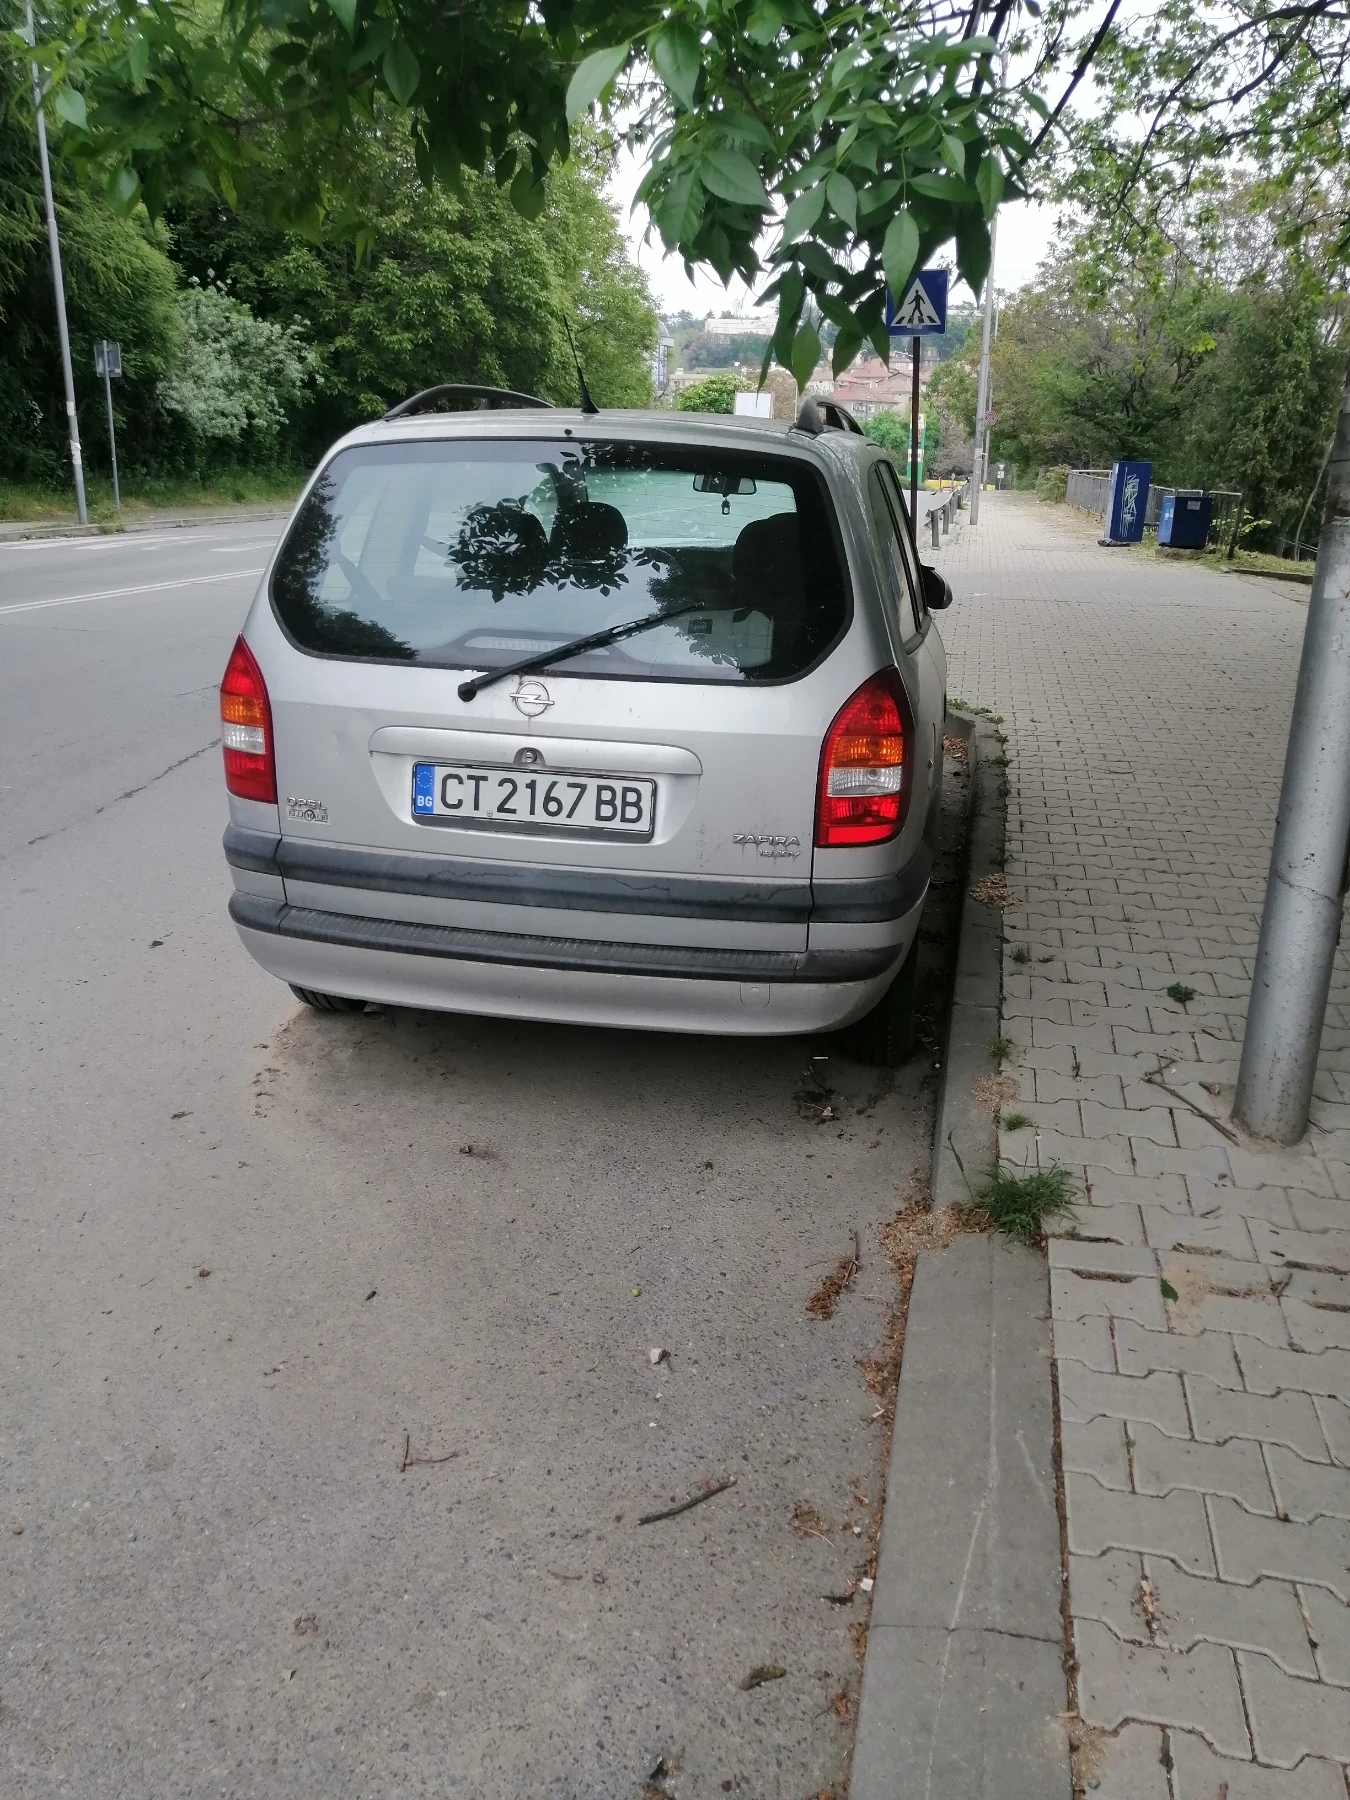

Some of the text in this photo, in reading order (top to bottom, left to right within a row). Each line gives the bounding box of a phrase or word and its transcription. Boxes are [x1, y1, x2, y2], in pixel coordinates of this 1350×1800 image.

[287, 797, 328, 811] OPEL
[417, 795, 433, 807] BG
[440, 773, 643, 824] CT 2167 BB
[733, 833, 801, 847] ZAFIRA
